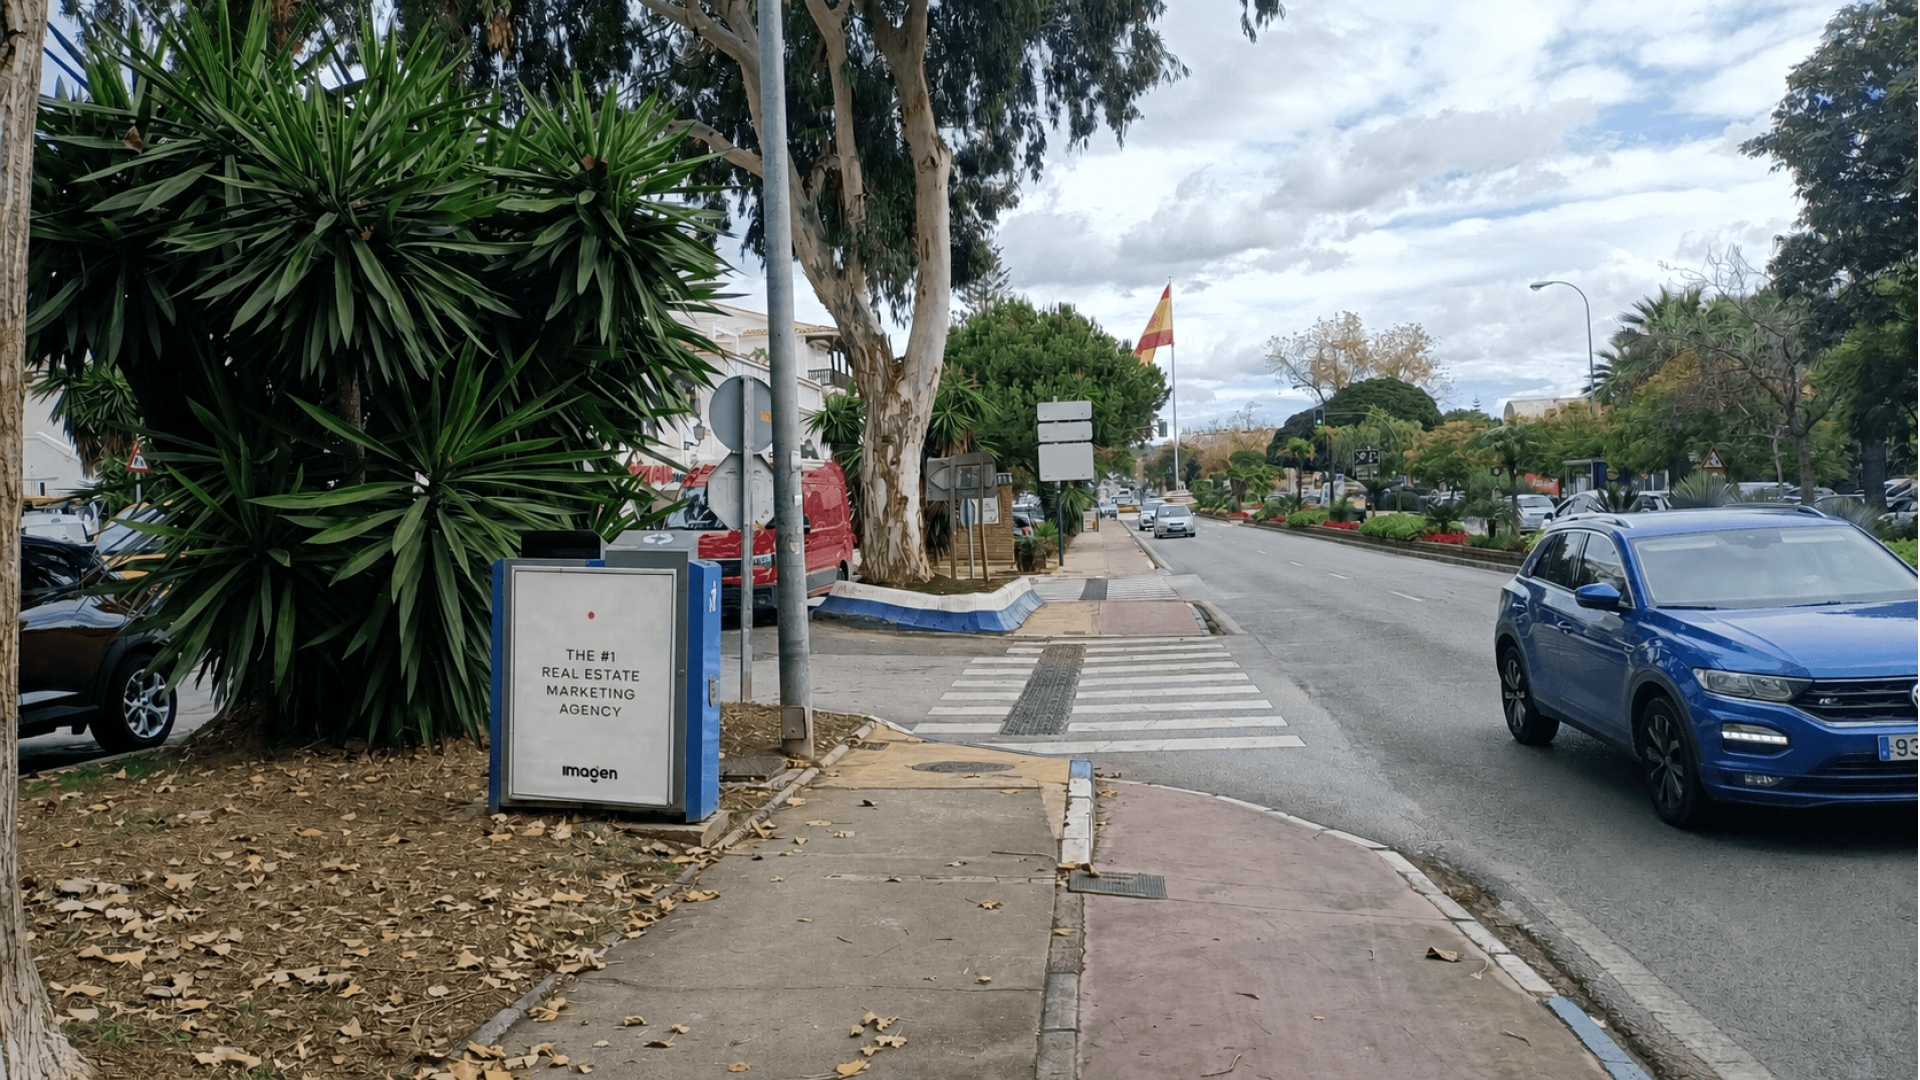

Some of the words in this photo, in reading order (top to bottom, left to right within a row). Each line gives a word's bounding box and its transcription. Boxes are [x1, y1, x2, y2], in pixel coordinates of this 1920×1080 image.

[566, 648, 595, 662] THE
[600, 650, 616, 662] #1
[542, 666, 580, 680] REAL
[584, 668, 640, 682] ESTATE
[546, 684, 635, 700] MARKETING
[559, 703, 622, 717] AGENCY
